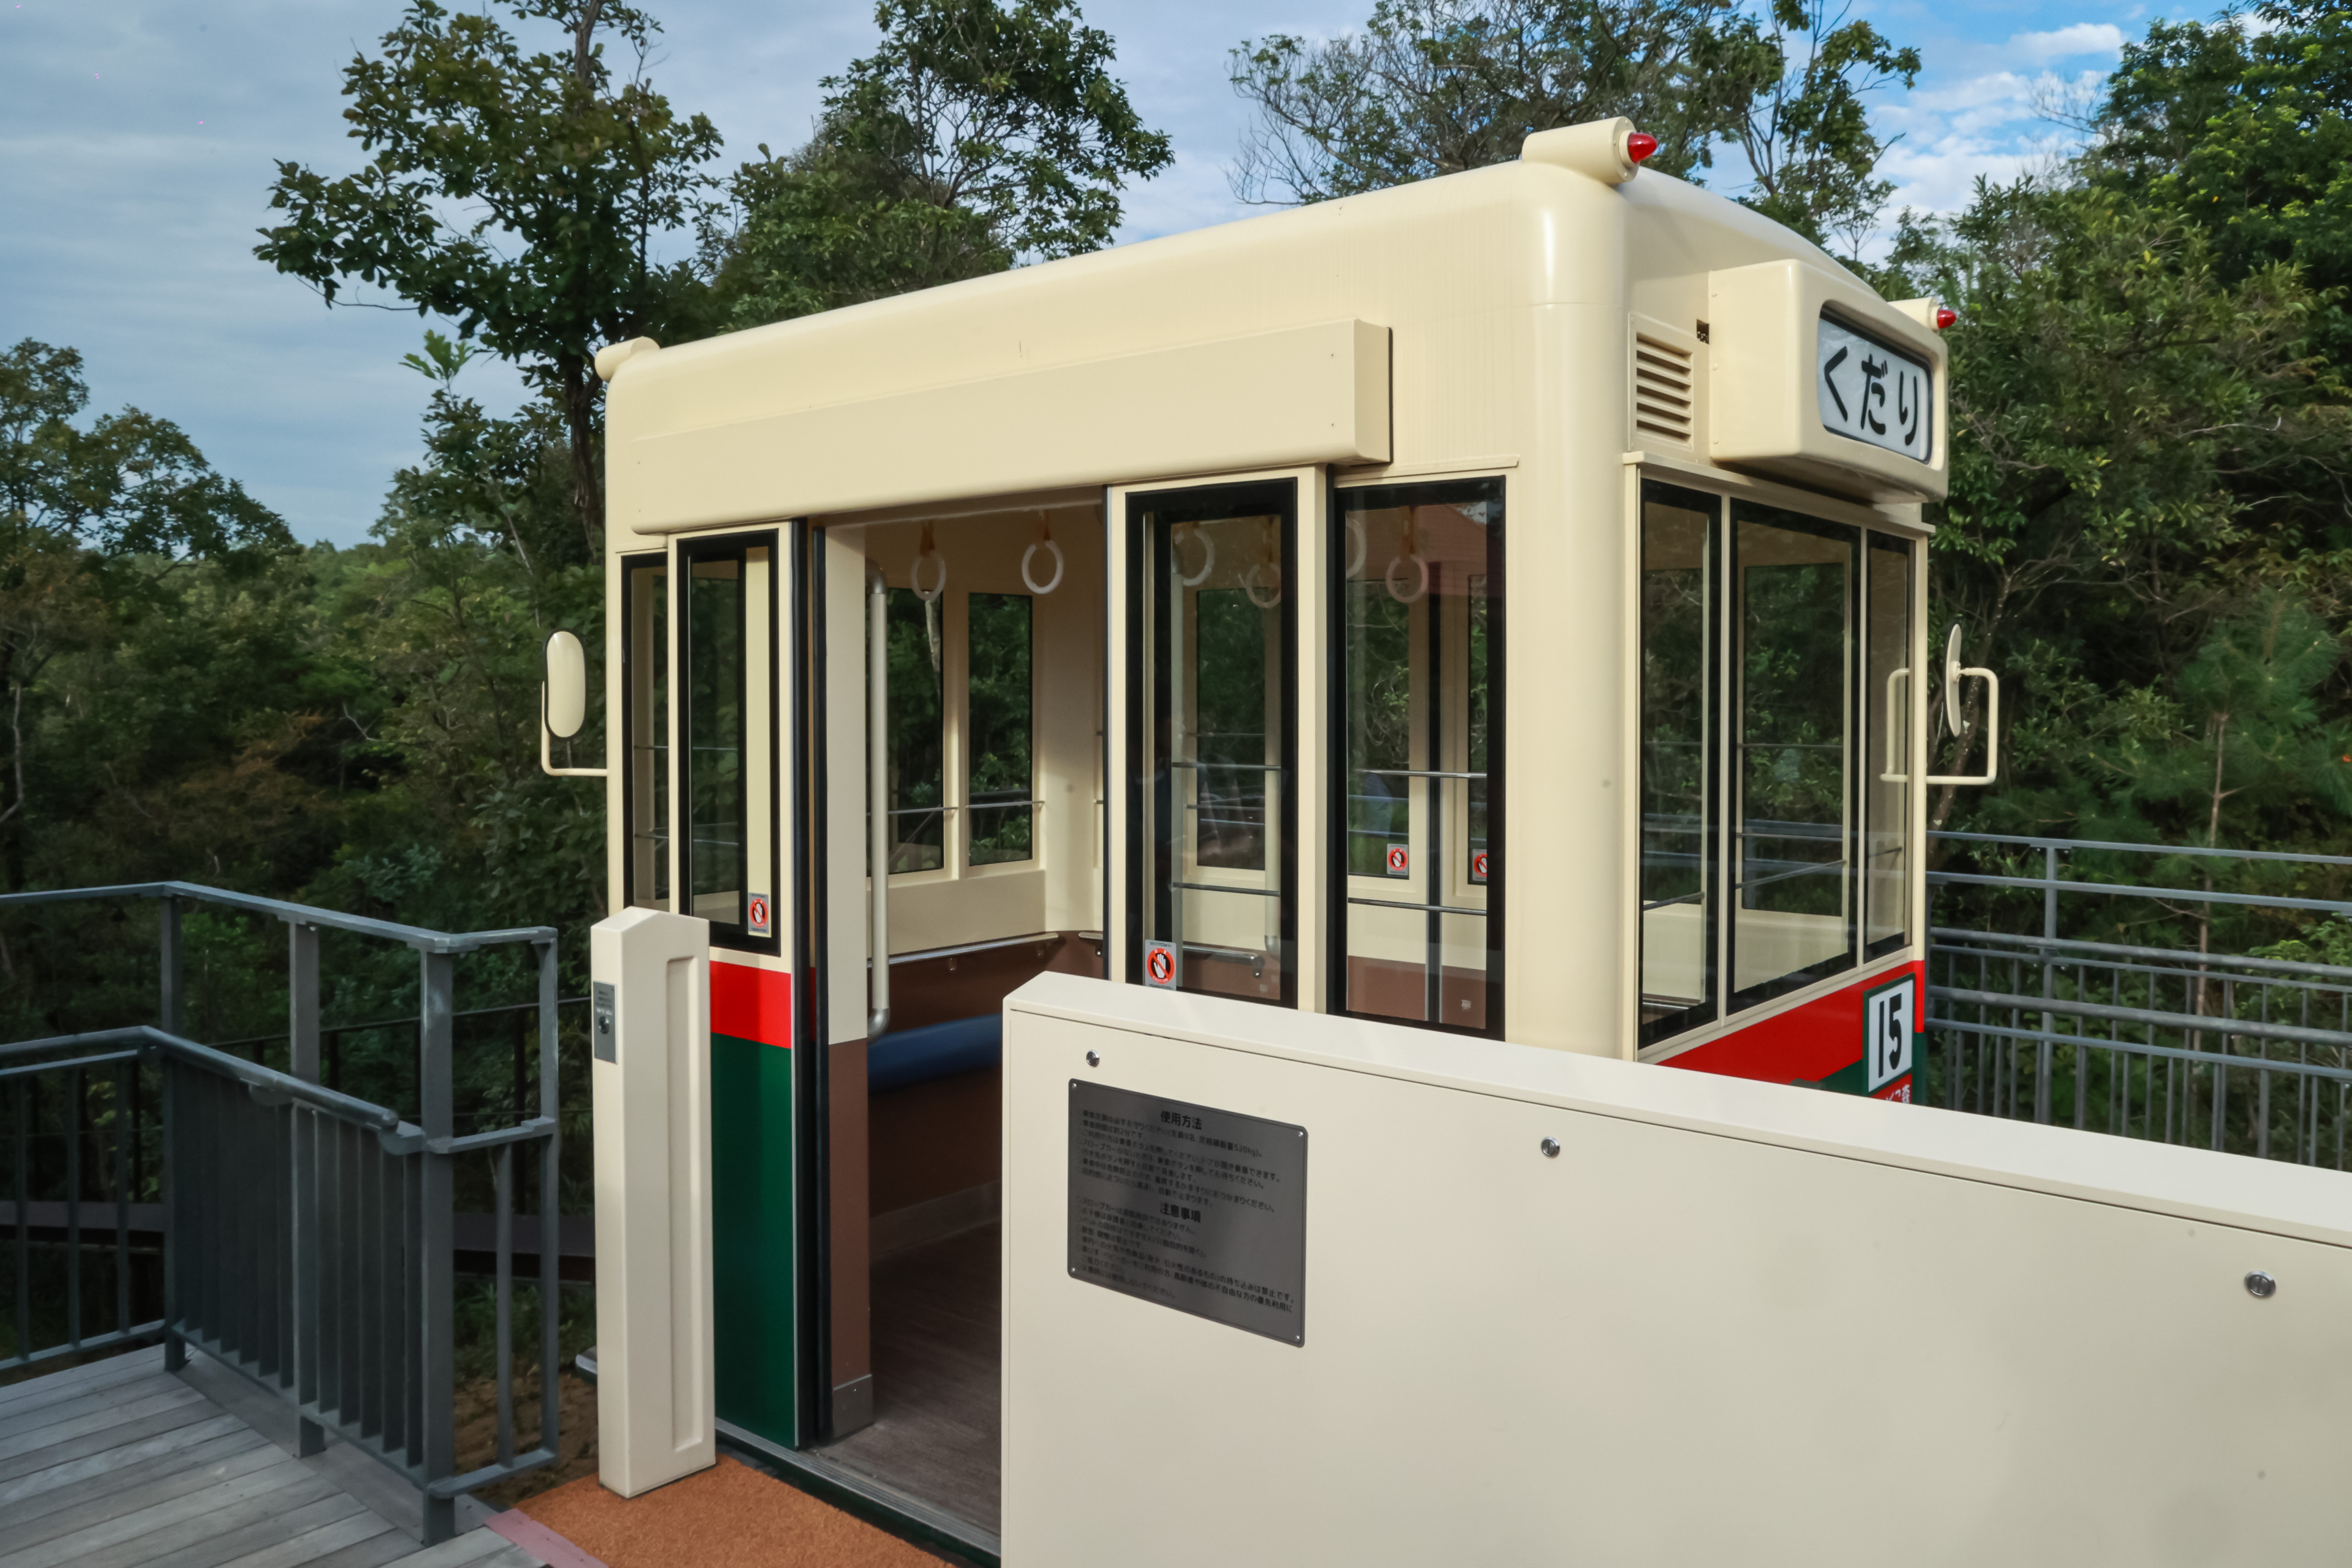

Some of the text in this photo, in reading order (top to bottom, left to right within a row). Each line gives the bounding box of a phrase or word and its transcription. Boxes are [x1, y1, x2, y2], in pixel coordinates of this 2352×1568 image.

[1824, 345, 1917, 446] くだり
[1878, 992, 1902, 1078] 15
[1161, 1110, 1202, 1131] 使用方法
[1083, 1138, 1264, 1190] スロープカーがないときは、ボタンを押してお待ちください。
[1160, 1201, 1201, 1223] 注意事項
